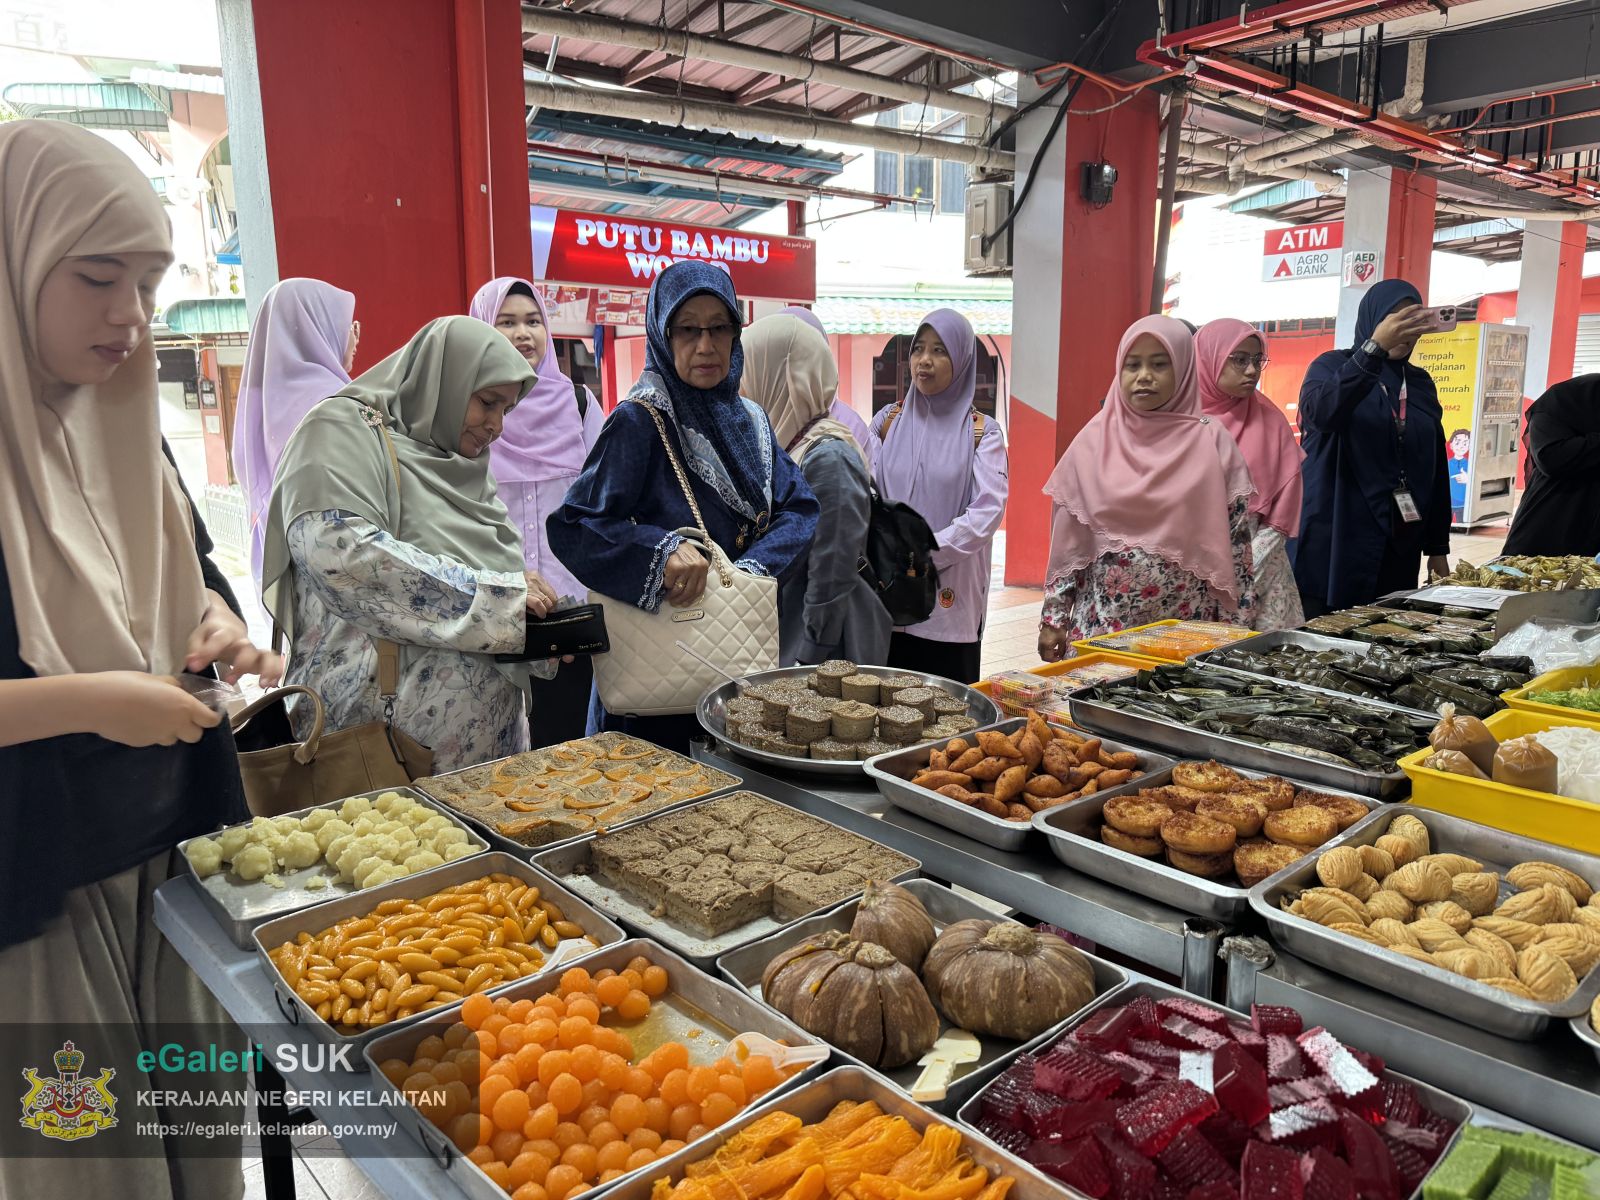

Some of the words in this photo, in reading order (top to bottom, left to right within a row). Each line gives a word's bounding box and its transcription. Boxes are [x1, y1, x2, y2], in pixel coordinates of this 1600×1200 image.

[575, 219, 662, 252] PUTU
[670, 230, 769, 263] BAMBU
[1278, 227, 1328, 250] ATM
[1297, 253, 1329, 265] AGRO
[1354, 253, 1375, 261] AED
[1296, 264, 1327, 275] BANK
[1418, 352, 1454, 361] Tempah
[1421, 362, 1466, 372] erjalanan
[1440, 385, 1470, 393] murah
